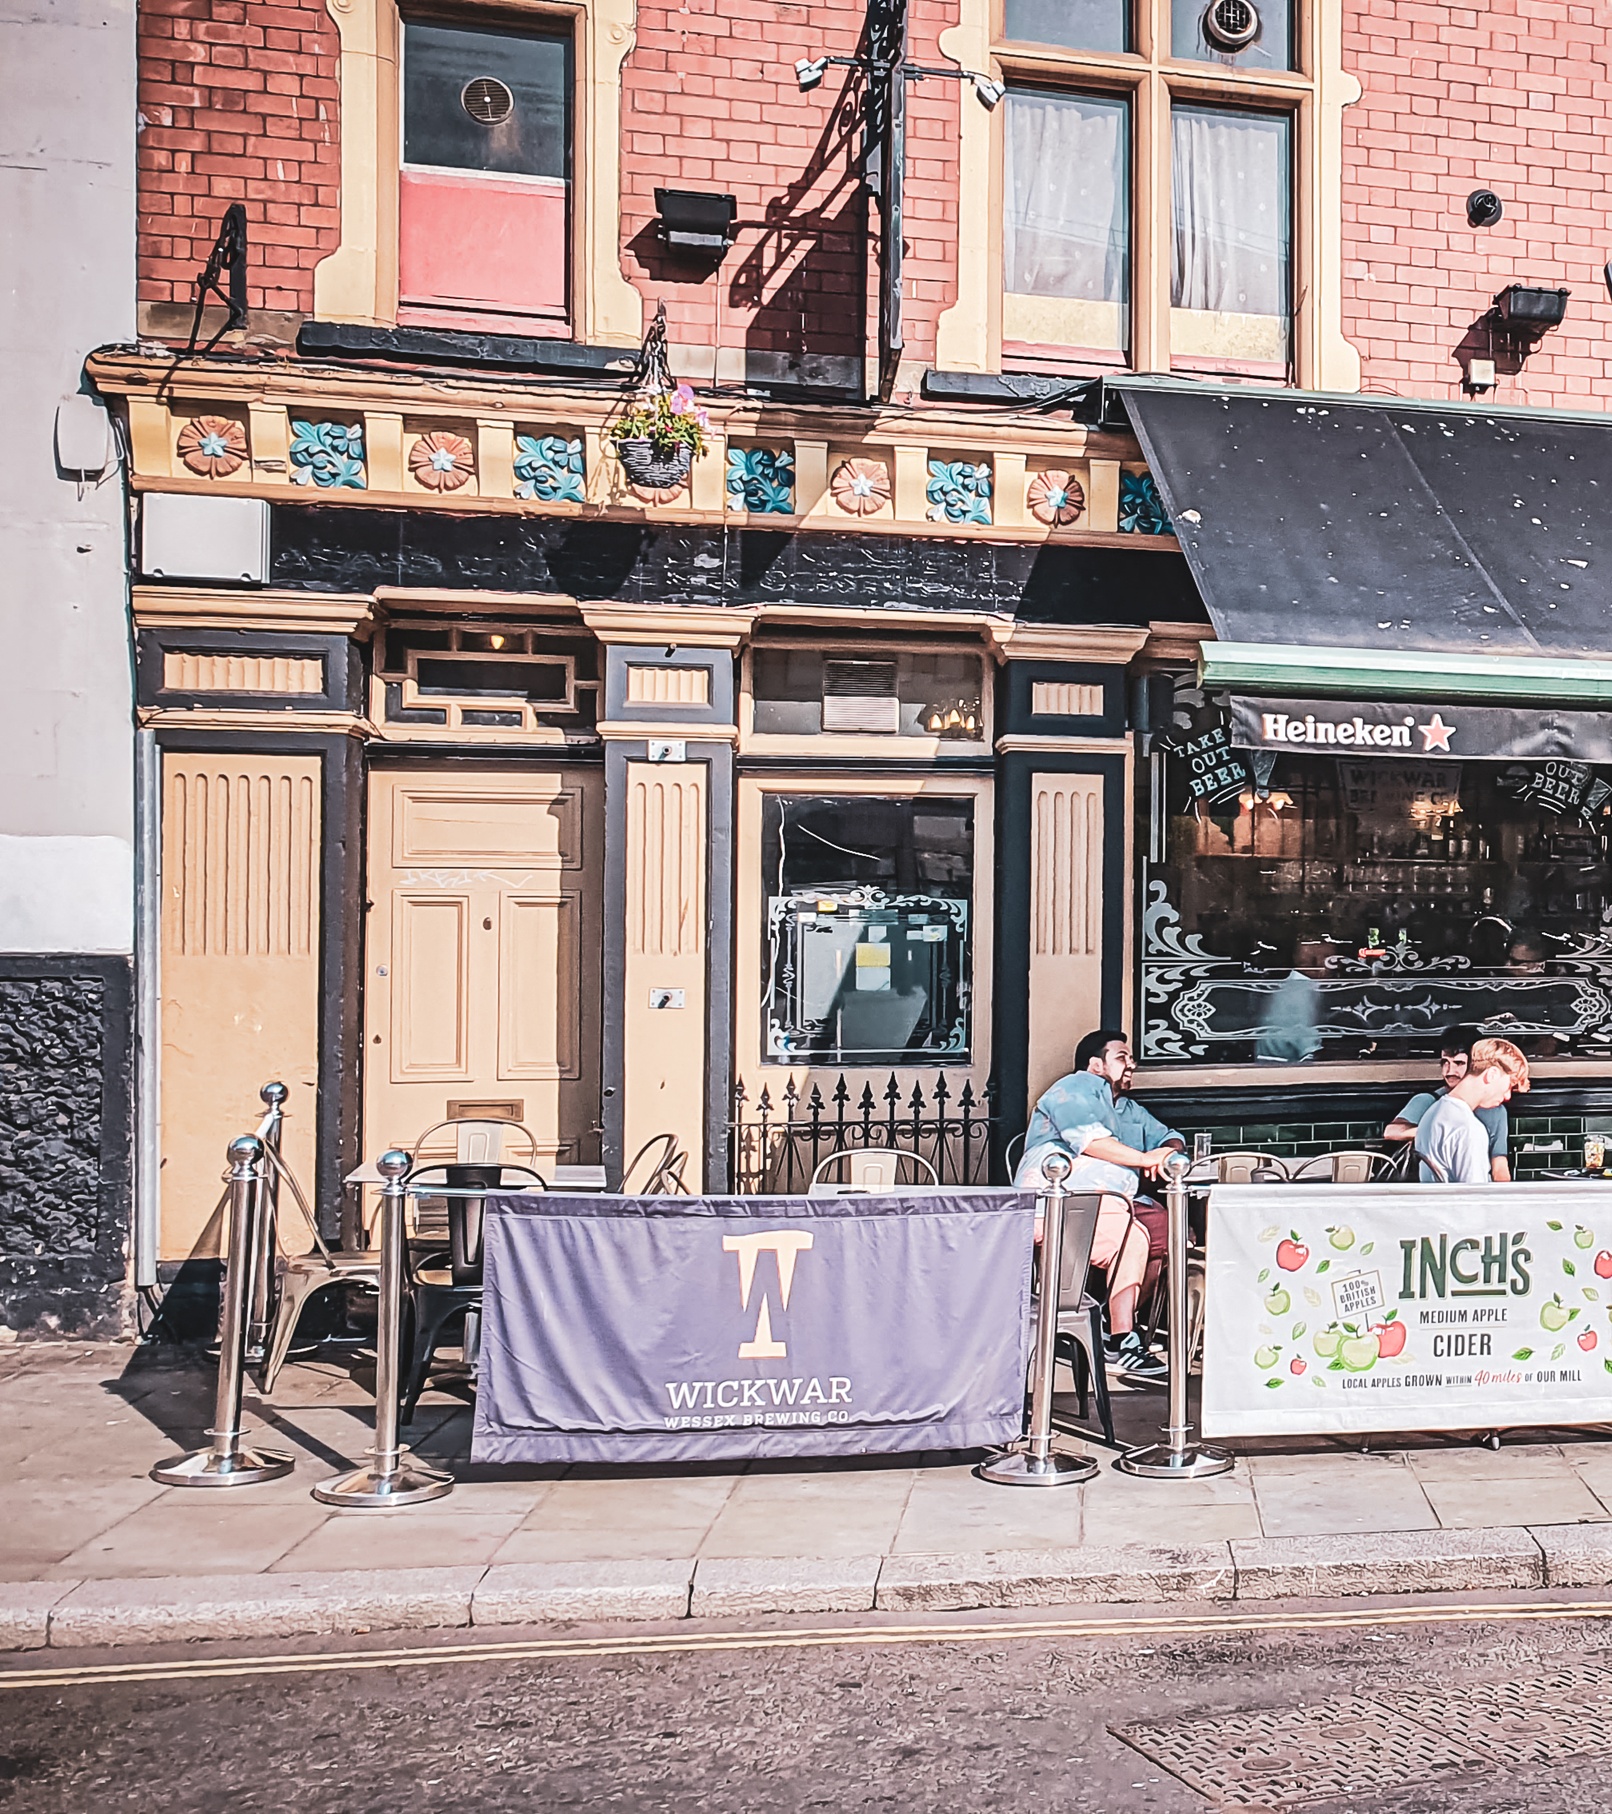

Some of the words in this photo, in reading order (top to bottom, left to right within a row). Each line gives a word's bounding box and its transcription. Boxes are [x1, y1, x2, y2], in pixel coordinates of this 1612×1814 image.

[1174, 727, 1226, 759] TAKE
[1191, 746, 1231, 774] OUT
[1189, 761, 1247, 797] BEER
[1545, 761, 1585, 786] OUT
[1531, 772, 1581, 805] BEER
[1340, 1285, 1376, 1304] BRITISH
[1342, 1280, 1370, 1293] 100%
[1344, 1296, 1377, 1313] APPLES
[1420, 1309, 1468, 1325] MEDIUM
[1472, 1308, 1508, 1322] APPLE
[1433, 1333, 1492, 1358] CIDER
[1342, 1378, 1368, 1389] LOCAL
[1371, 1376, 1402, 1388] APPLES
[1404, 1374, 1443, 1387] GROWN
[1445, 1375, 1472, 1385] WITHIN
[1474, 1370, 1490, 1386] 40
[1491, 1369, 1523, 1384] miles
[1536, 1370, 1556, 1383] OUR
[1559, 1369, 1582, 1382] MILL
[664, 1376, 853, 1410] WICKWAR
[664, 1414, 737, 1429] WESSEX
[742, 1411, 821, 1426] BREWING
